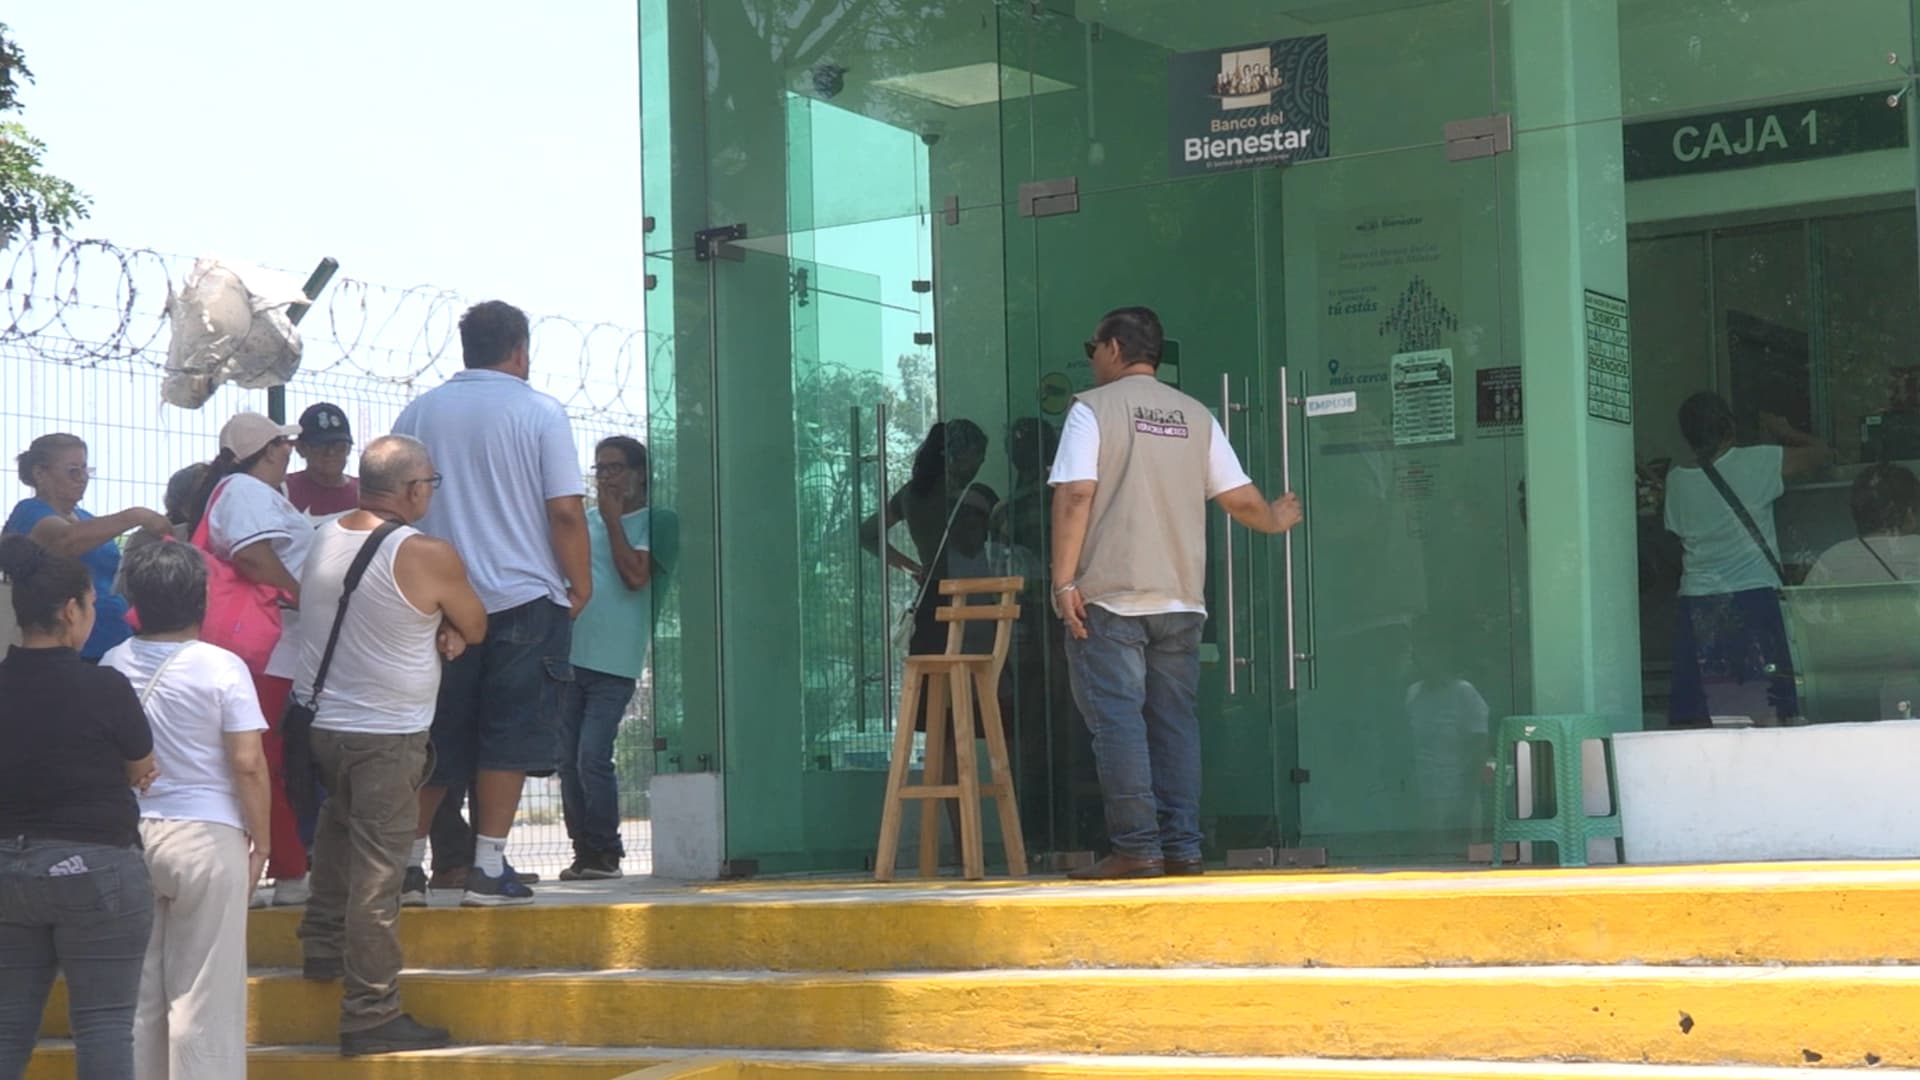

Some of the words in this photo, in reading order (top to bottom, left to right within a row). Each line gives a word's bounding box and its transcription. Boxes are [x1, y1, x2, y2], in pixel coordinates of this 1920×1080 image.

[1210, 119, 1257, 133] Banco
[1260, 111, 1284, 125] del
[1672, 114, 1789, 162] CAJA
[1801, 109, 1817, 145] 1
[1184, 127, 1311, 162] Bienestar
[1344, 298, 1378, 315] estás
